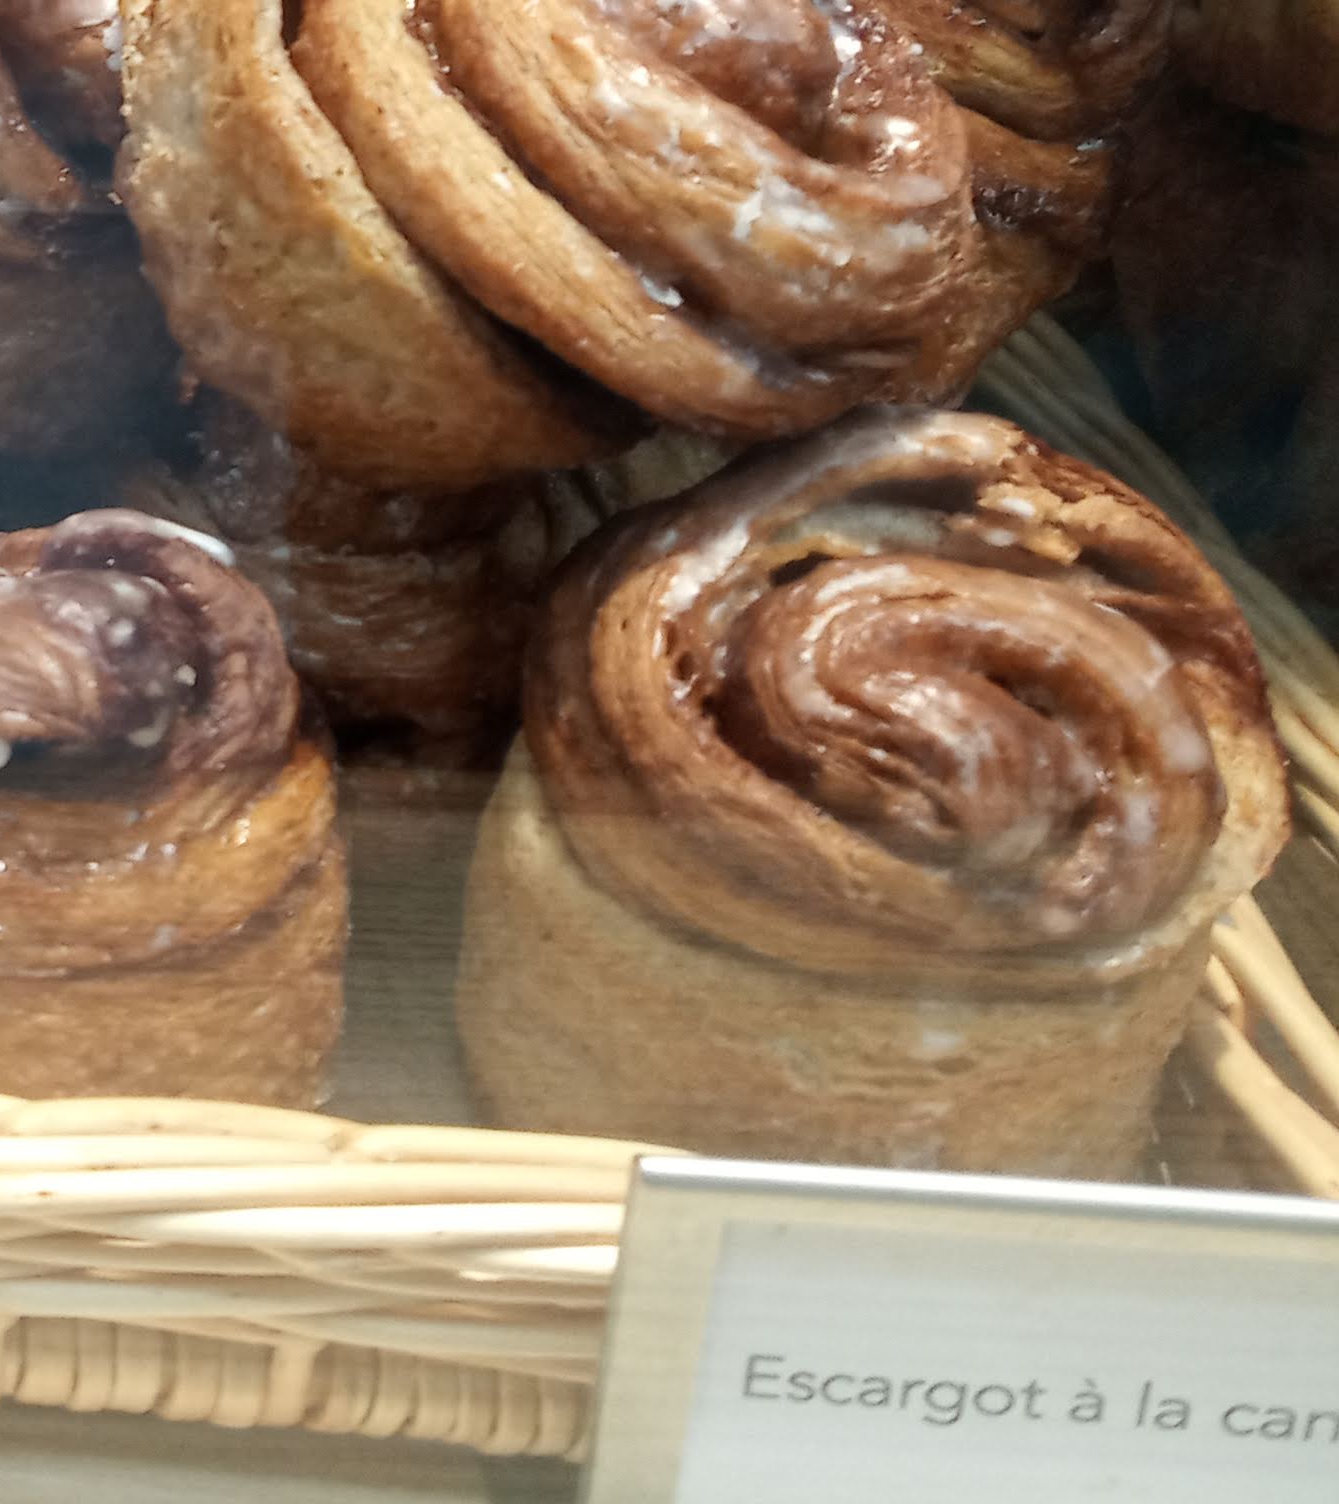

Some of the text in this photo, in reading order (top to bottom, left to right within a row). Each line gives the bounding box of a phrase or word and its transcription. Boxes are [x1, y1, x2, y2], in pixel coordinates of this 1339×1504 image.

[741, 1352, 1045, 1427] Escargot
[1068, 1377, 1106, 1425] à
[1135, 1380, 1191, 1431] la
